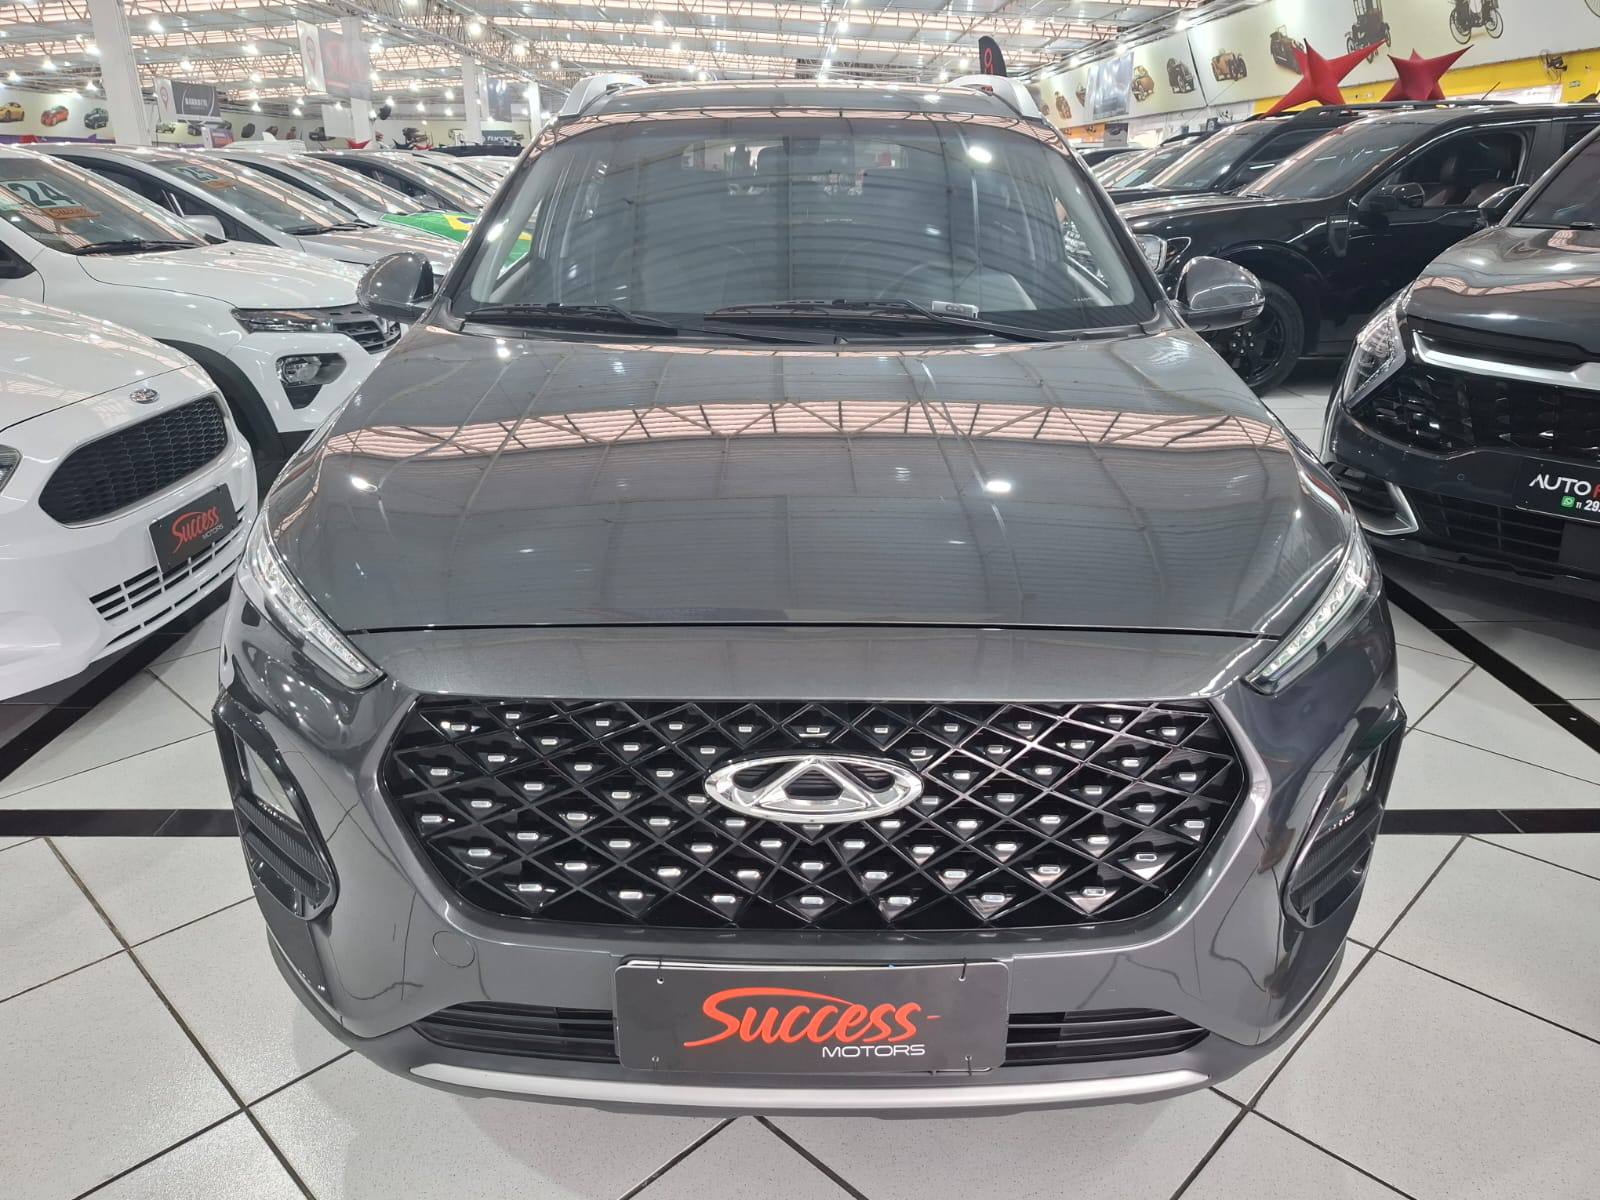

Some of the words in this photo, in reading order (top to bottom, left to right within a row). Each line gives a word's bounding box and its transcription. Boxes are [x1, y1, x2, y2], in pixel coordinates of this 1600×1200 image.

[7, 183, 76, 206] 24
[1529, 473, 1592, 496] AUTO
[171, 506, 220, 554] Success
[684, 986, 922, 1047] Success
[822, 1044, 926, 1058] MOTORS
